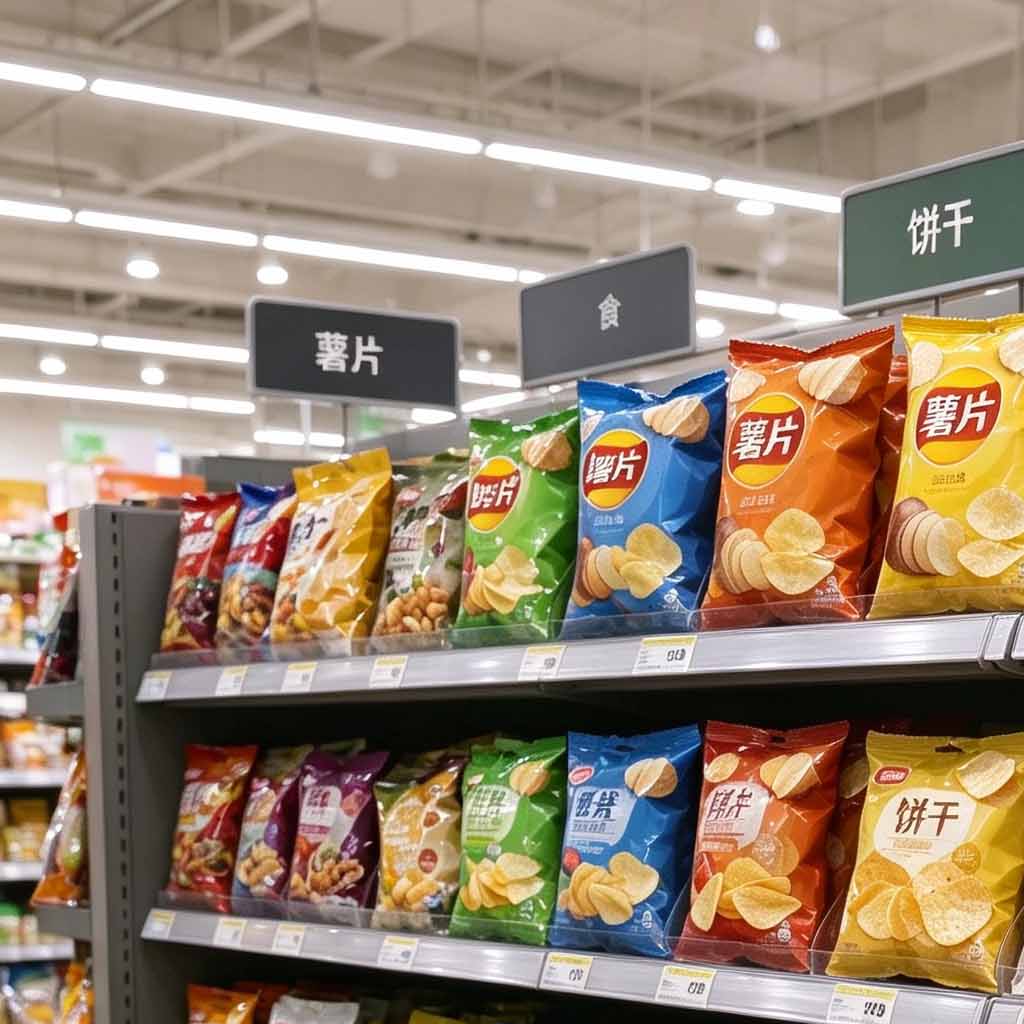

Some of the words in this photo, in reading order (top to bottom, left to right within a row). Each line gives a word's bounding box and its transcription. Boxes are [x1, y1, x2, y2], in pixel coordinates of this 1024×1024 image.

[907, 199, 973, 255] 饼干
[315, 332, 384, 376] 薯片
[919, 390, 996, 437] 薯片
[732, 416, 799, 459] 薯片
[896, 798, 959, 837] 饼干
